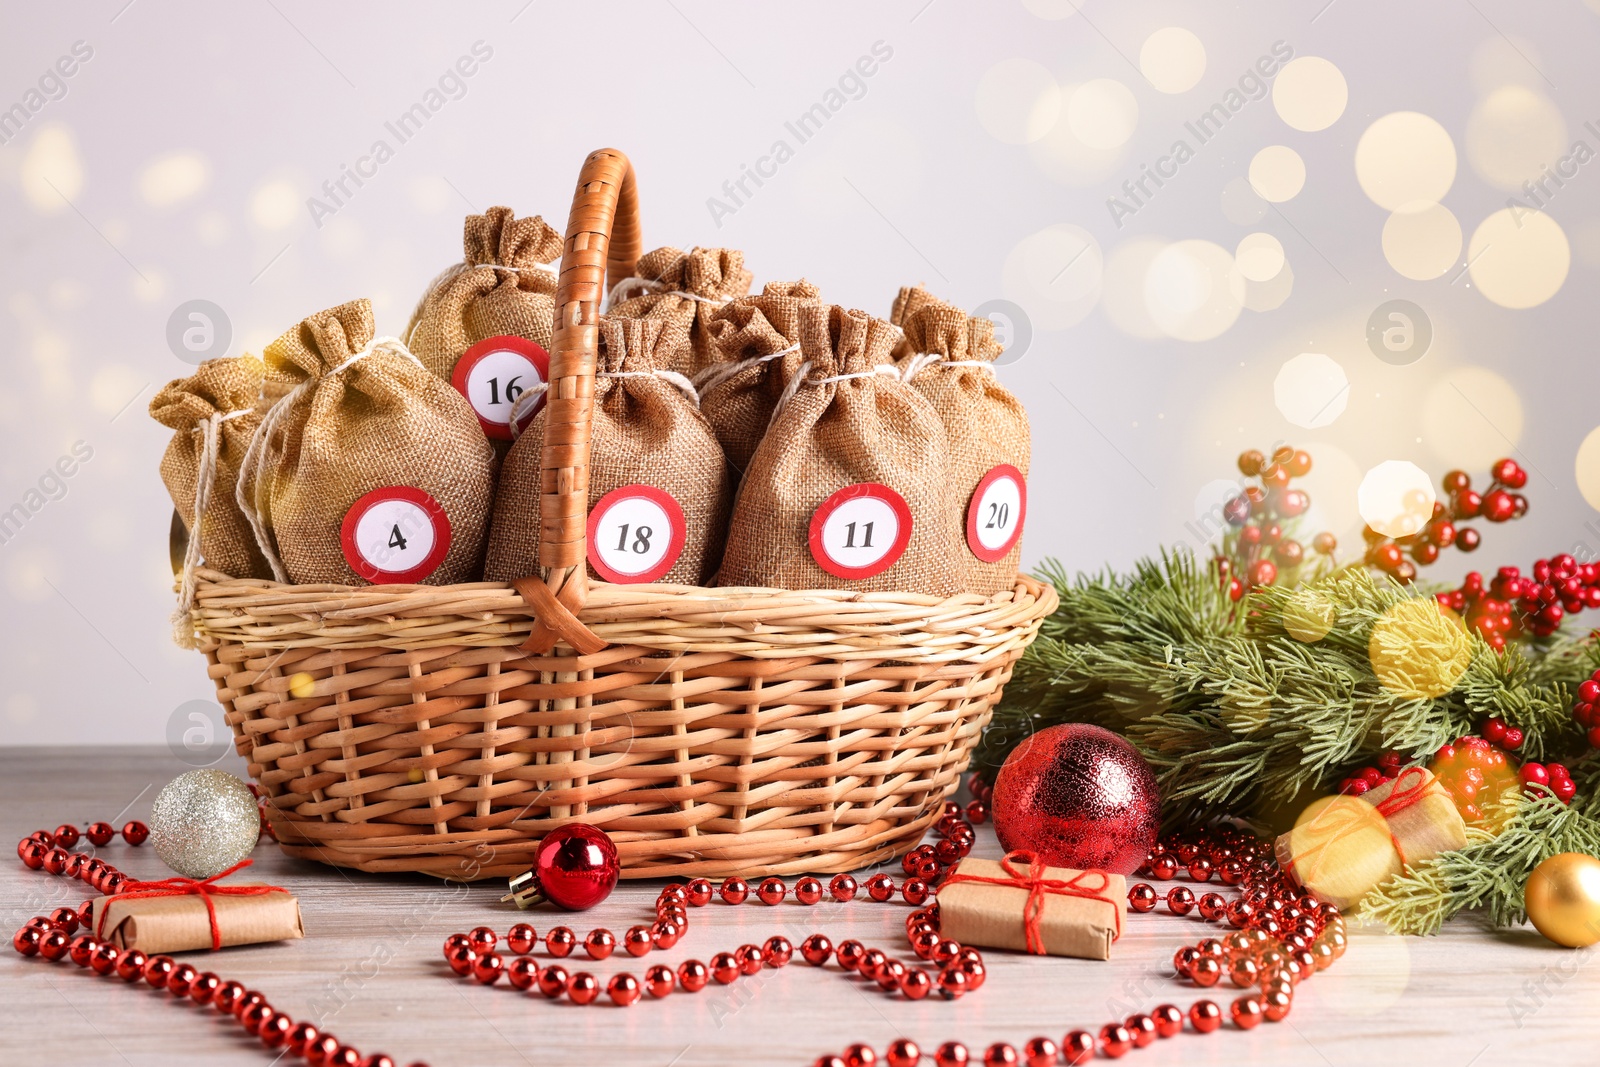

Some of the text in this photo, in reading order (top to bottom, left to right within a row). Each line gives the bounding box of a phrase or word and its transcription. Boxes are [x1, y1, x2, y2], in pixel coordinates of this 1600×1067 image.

[486, 375, 524, 405] 16
[985, 502, 1009, 529] 20
[388, 523, 407, 550] 4
[613, 523, 653, 554] 18
[842, 521, 875, 548] 11
